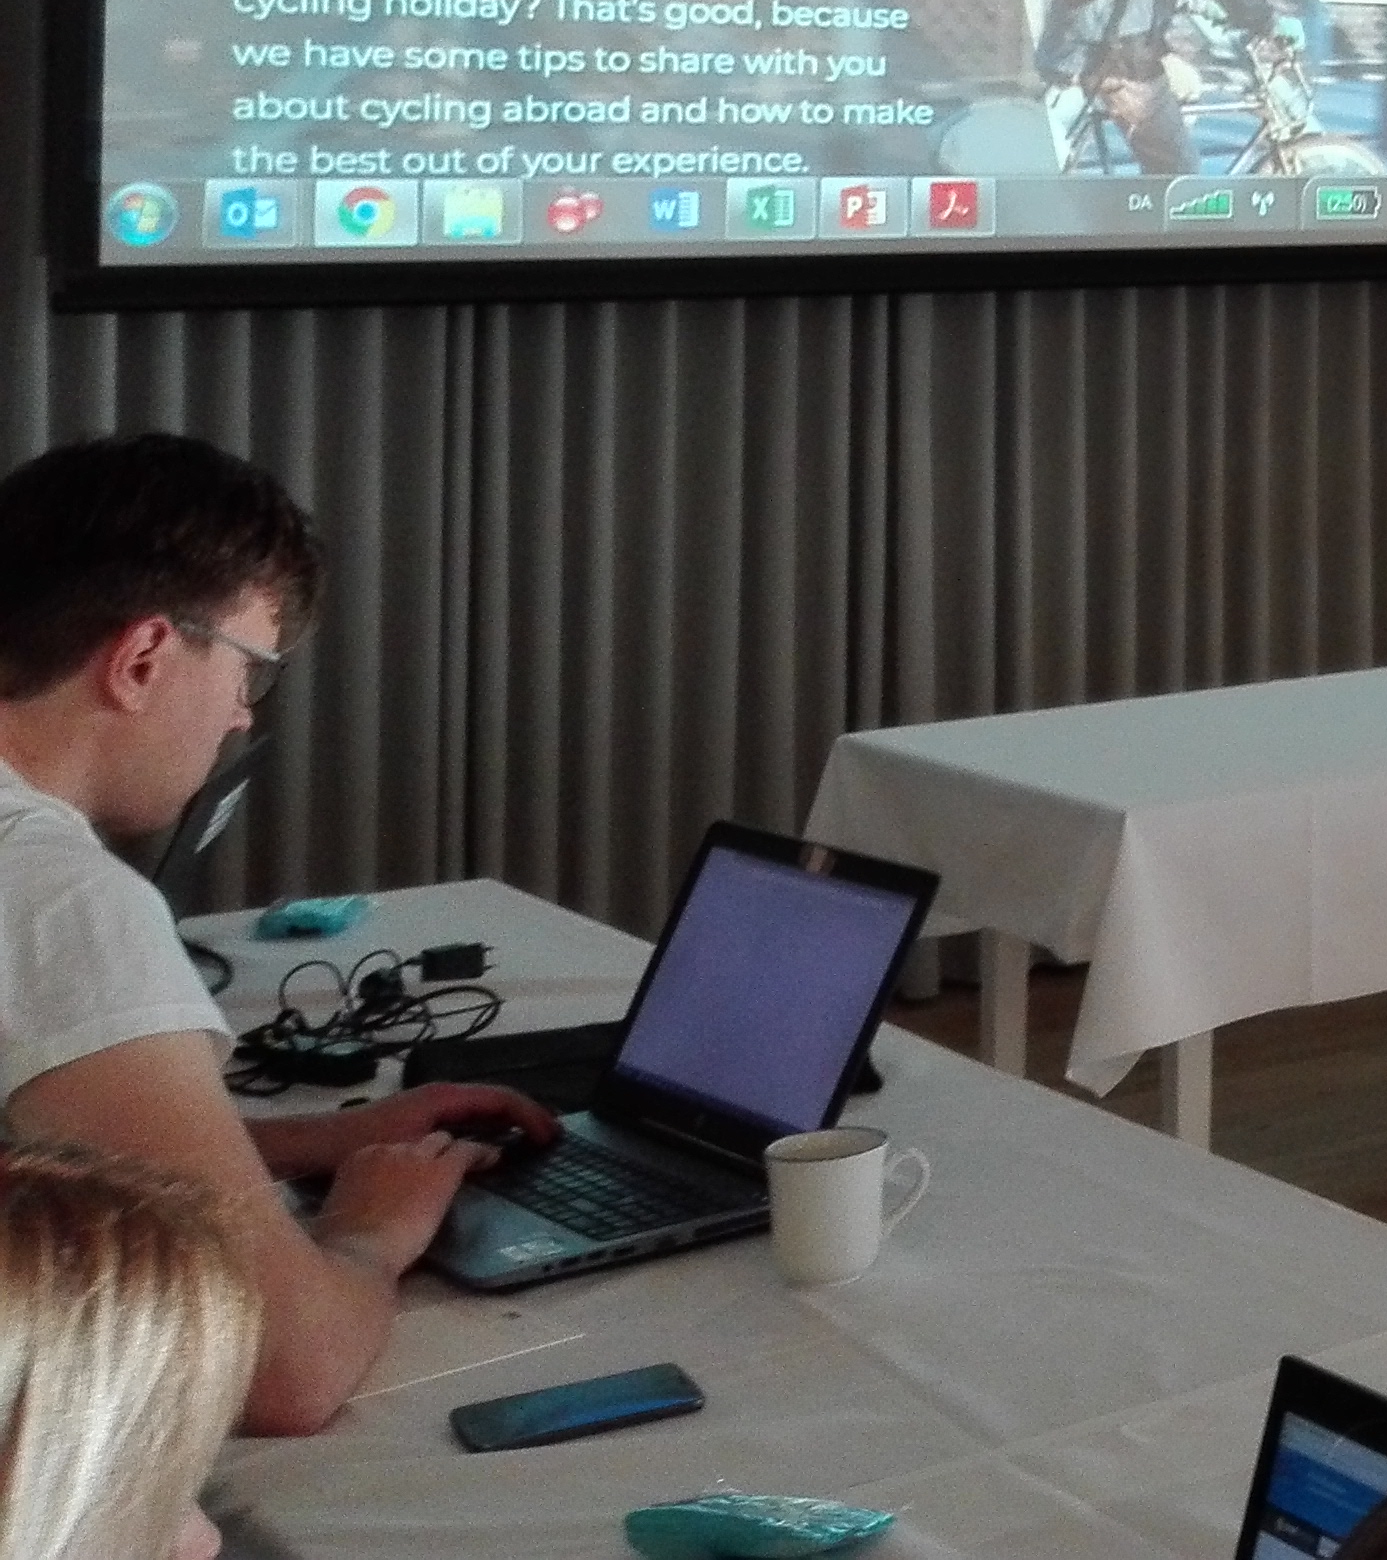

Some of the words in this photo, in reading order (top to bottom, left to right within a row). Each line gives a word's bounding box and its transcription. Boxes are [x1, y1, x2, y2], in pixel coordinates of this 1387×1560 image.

[771, 0, 910, 30] because
[232, 43, 292, 68] we
[304, 37, 395, 69] have
[404, 44, 509, 72] some
[517, 42, 586, 78] tips
[594, 49, 632, 74] to
[638, 45, 735, 75] share
[742, 48, 819, 77] with
[824, 53, 887, 83] you
[232, 90, 350, 121] about
[360, 93, 493, 129] cycling
[502, 94, 631, 125] abroad
[640, 96, 708, 126] and
[717, 97, 793, 125] how
[800, 99, 834, 126] to
[842, 98, 935, 127] make
[231, 145, 299, 175] the
[309, 144, 393, 175] best
[402, 146, 466, 175] out
[476, 144, 517, 175] of
[521, 149, 602, 179] your
[611, 145, 810, 179] experience.
[1128, 193, 1153, 211] DA
